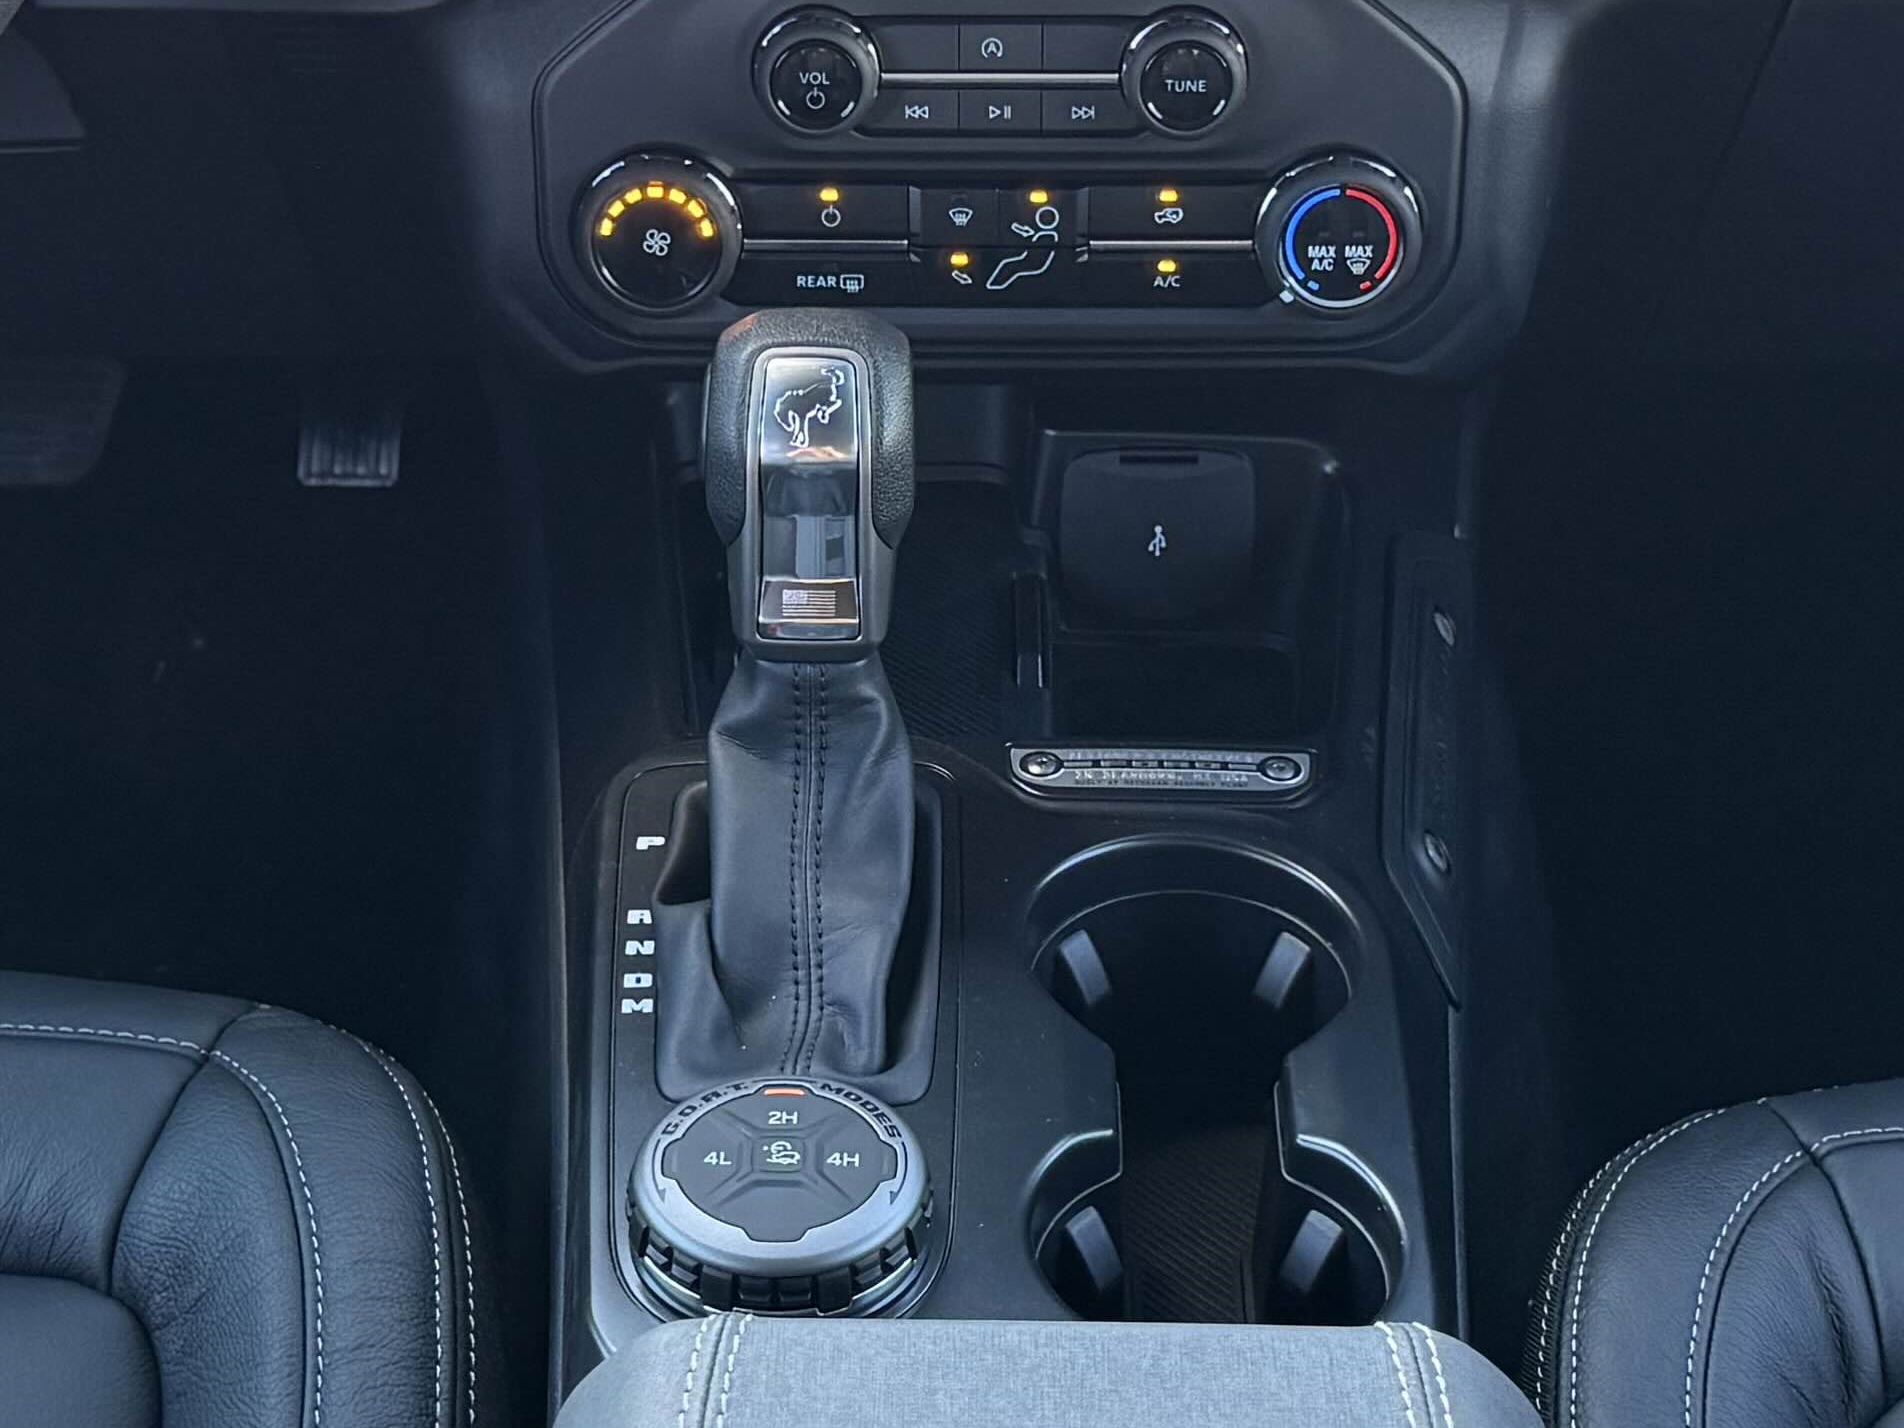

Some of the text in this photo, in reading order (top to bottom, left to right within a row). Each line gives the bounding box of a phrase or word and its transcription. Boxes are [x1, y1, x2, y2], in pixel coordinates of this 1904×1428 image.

[799, 72, 830, 86] VOL
[1165, 80, 1207, 93] TUNE
[1307, 245, 1336, 260] MAX
[1344, 245, 1373, 260] MAX
[1311, 258, 1334, 273] A/C
[796, 275, 837, 288] REAR
[1154, 275, 1180, 288] A/C
[635, 835, 666, 851] P
[625, 940, 655, 955] N
[623, 973, 653, 988] D
[621, 998, 653, 1013] M
[767, 1111, 798, 1125] 2H
[819, 1083, 902, 1140] MODES
[703, 1152, 732, 1165] 4L
[826, 1153, 860, 1167] 4H
